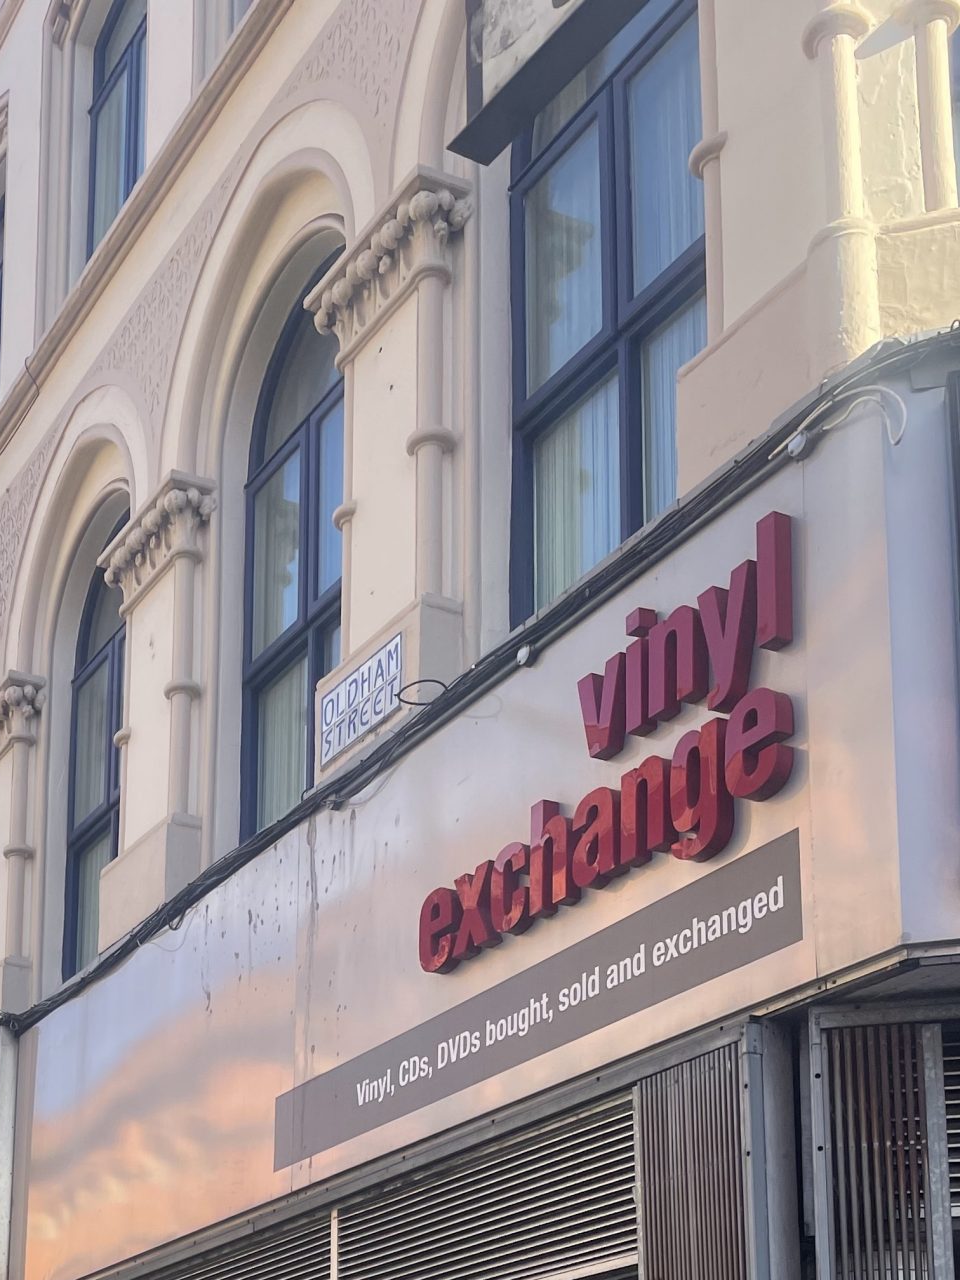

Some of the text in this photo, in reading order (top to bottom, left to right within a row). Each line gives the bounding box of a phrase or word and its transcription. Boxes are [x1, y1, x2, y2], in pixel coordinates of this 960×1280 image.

[324, 642, 400, 728] OLDHAM
[325, 676, 398, 758] STREET
[577, 511, 793, 760] vinyl
[418, 687, 794, 973] exchange
[356, 875, 785, 1106] Vinyl, CDs, DVDs bought, sold and exchanged
